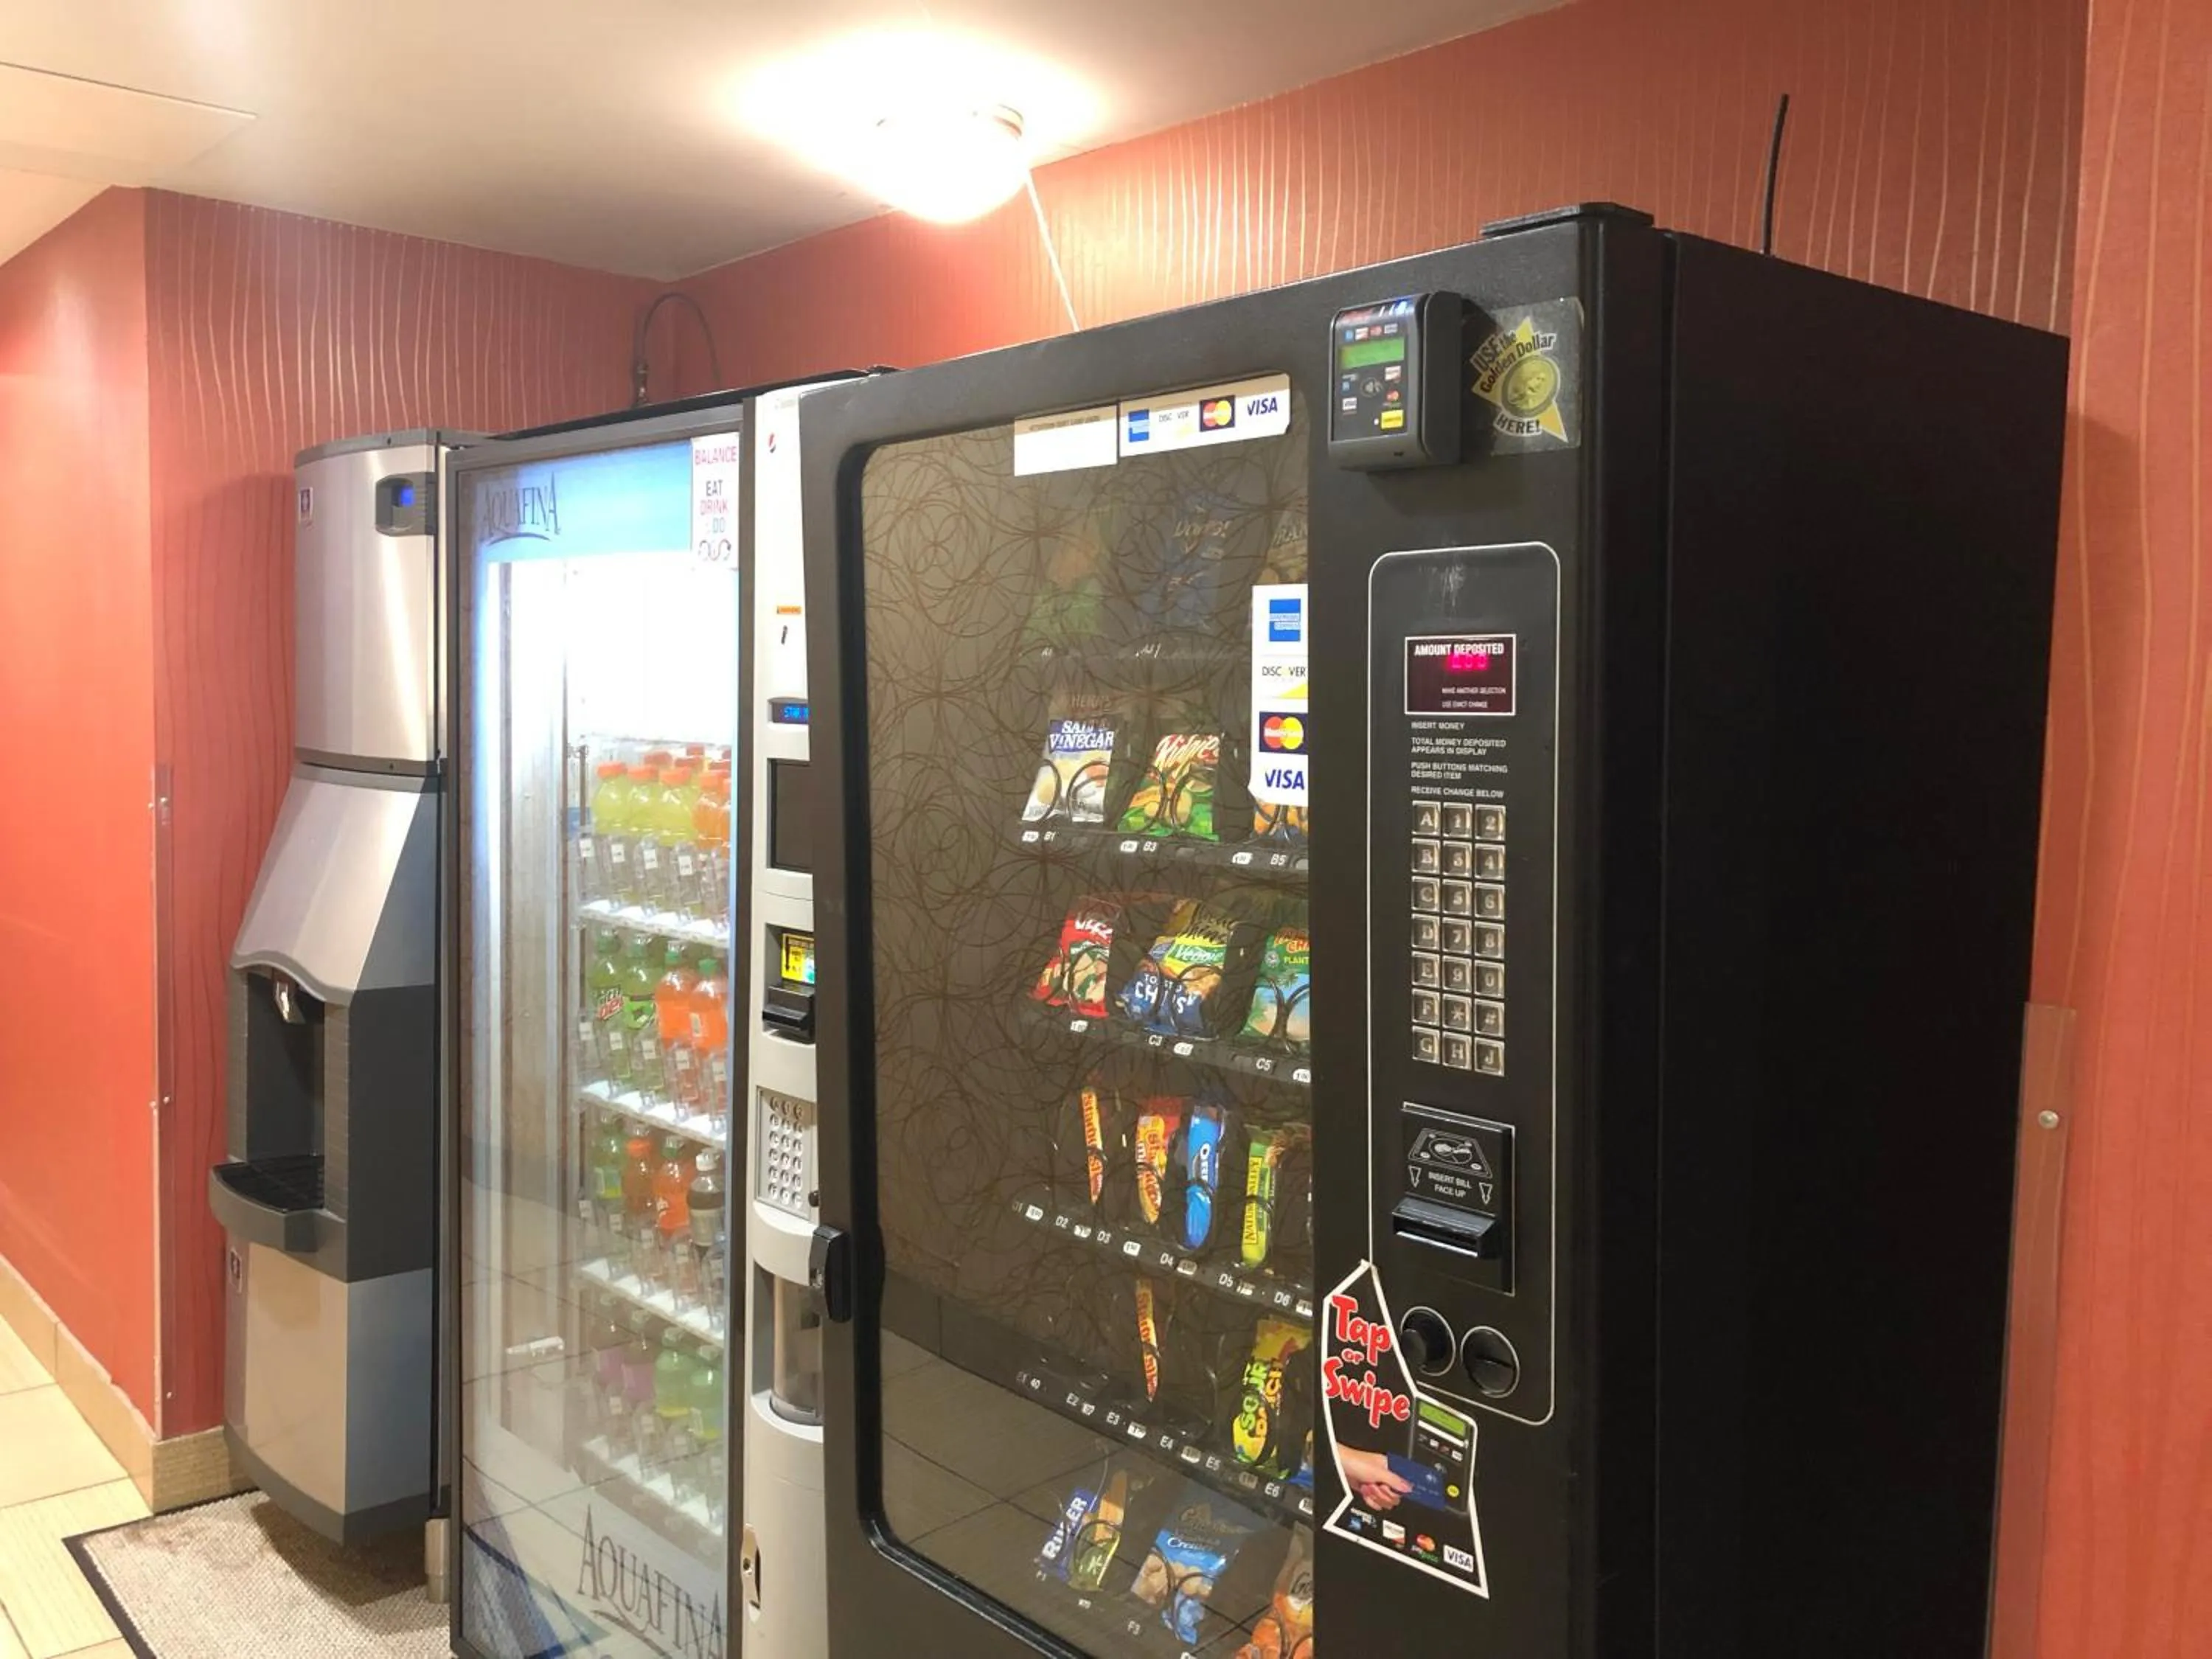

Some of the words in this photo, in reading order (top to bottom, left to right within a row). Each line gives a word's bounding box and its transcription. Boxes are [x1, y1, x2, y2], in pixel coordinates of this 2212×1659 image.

[1475, 336, 1500, 369] USE
[1480, 352, 1517, 394] Golden
[1516, 334, 1554, 358] Dollar
[1246, 397, 1279, 417] VISA
[1158, 410, 1189, 423] DISCVER
[1497, 414, 1541, 434] HERE!
[695, 446, 737, 465] BALANCE
[706, 479, 723, 497] EAT
[479, 470, 561, 543] AQUAFINA
[700, 498, 728, 516] DRINK
[1414, 644, 1452, 656] AMOUNT
[1453, 642, 1505, 655] DEPOSITED
[1262, 666, 1307, 678] DISCVER
[1439, 722, 1464, 730] MONEY
[1050, 730, 1115, 749] VINEGAR
[1411, 737, 1433, 745] TOTAL
[1436, 737, 1461, 746] MONEY
[1463, 738, 1506, 747] DEPOSITED
[1411, 746, 1445, 754] APPEARS
[1411, 762, 1430, 771] PUSH
[1433, 762, 1467, 771] BUTTONS
[1468, 764, 1508, 773] MATCHING
[1265, 769, 1305, 790] VISA
[1443, 787, 1475, 796] CHANGE
[1476, 788, 1504, 798] BELOW
[1420, 811, 1433, 827] A
[1485, 815, 1495, 830] 2
[1484, 855, 1495, 869] 4
[1420, 887, 1433, 902] C
[1484, 894, 1495, 909] 6
[1453, 930, 1462, 944] 7
[1422, 963, 1433, 978] E
[1420, 1037, 1433, 1053] G
[1451, 1043, 1464, 1060] H
[1484, 1049, 1494, 1065] J
[1256, 1057, 1272, 1071] C5
[1428, 1171, 1455, 1183] INSERT
[1455, 1178, 1472, 1189] BILL
[1434, 1183, 1454, 1196] FACE
[1455, 1188, 1467, 1198] UP
[1160, 1252, 1174, 1267] D4
[1219, 1273, 1234, 1287] D5
[1331, 1294, 1392, 1366] Tap
[1324, 1356, 1411, 1429] Swipe
[1264, 1482, 1281, 1498] E6
[1447, 1549, 1472, 1568] VISA
[578, 1503, 724, 1659] AQUAFINA
